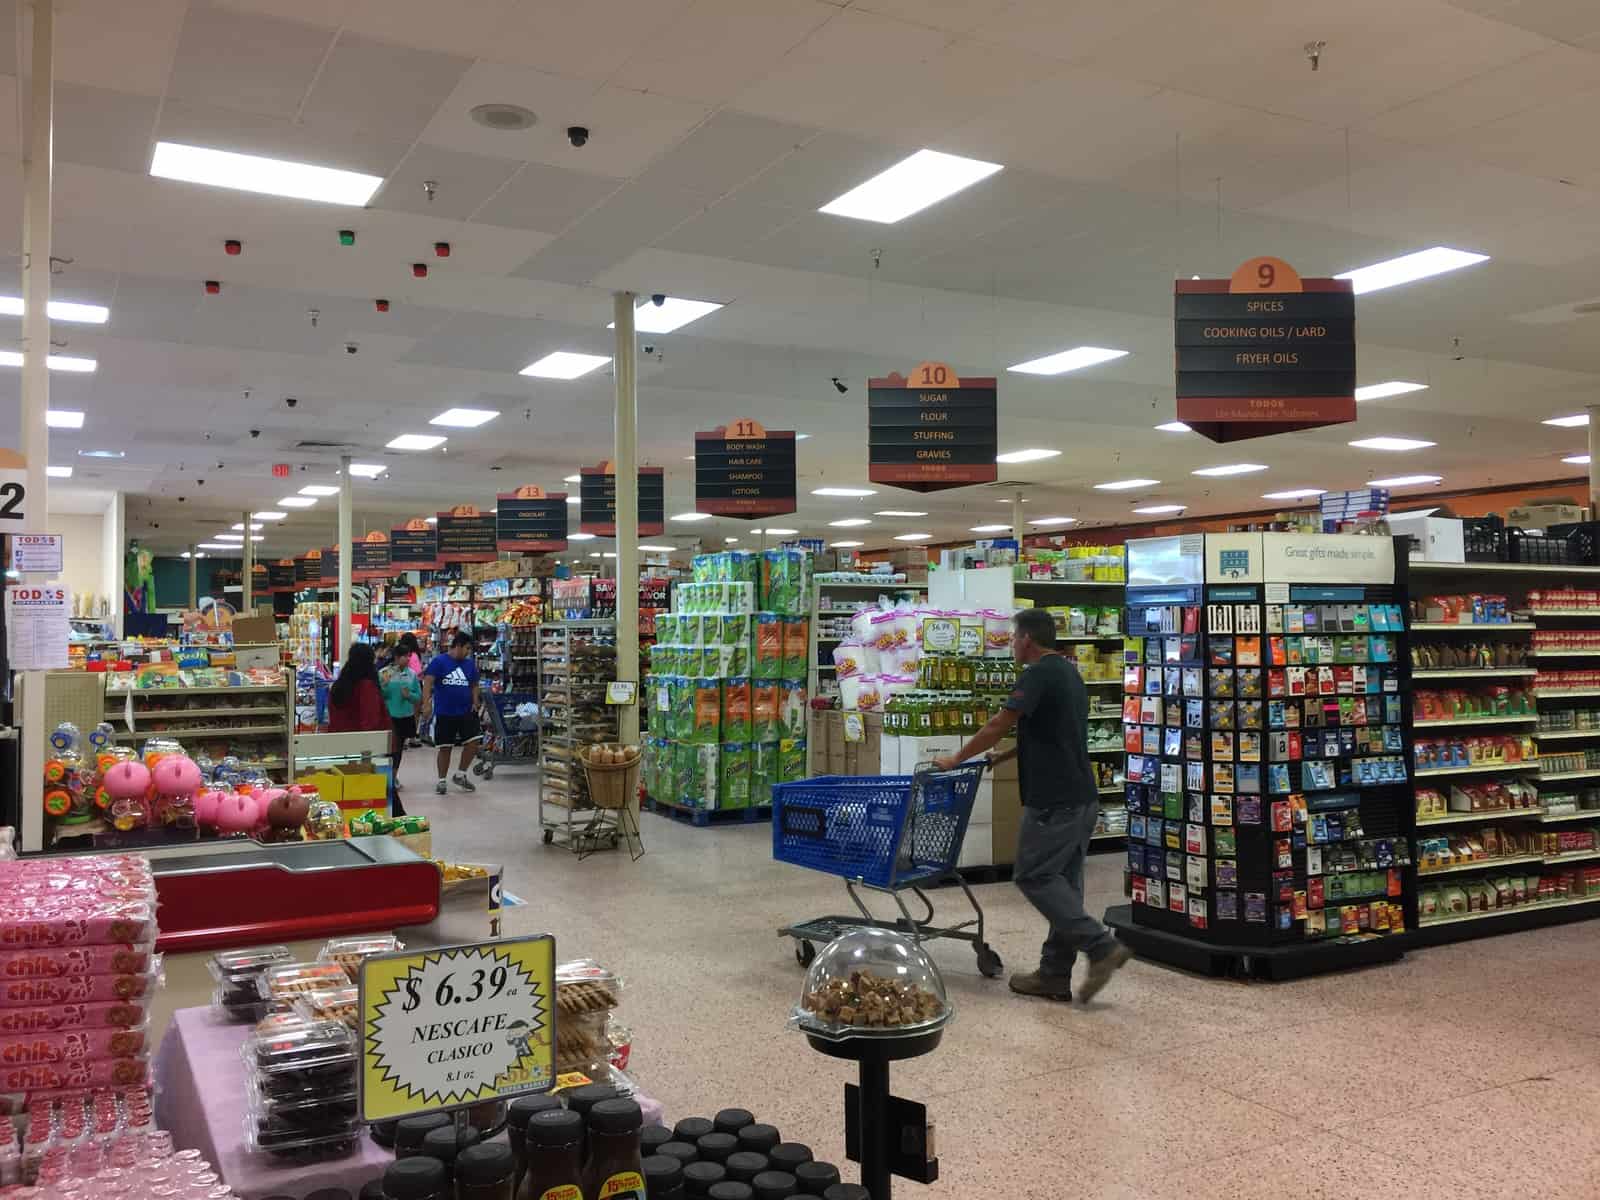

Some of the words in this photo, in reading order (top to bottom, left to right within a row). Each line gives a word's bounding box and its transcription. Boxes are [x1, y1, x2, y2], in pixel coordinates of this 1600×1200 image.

[1257, 264, 1275, 289] 9
[1247, 301, 1284, 312] SPICES
[1204, 327, 1257, 339] COOKING
[1259, 327, 1285, 338] OILS
[1287, 326, 1293, 339] /
[1296, 326, 1326, 337] LARD
[1236, 353, 1270, 364] FRYER
[1273, 353, 1298, 364] OILS
[921, 366, 947, 385] 10
[919, 393, 948, 402] SUGAR
[920, 412, 948, 421] FLOUR
[736, 422, 754, 436] 11
[913, 431, 954, 440] STUFFING
[916, 450, 951, 459] GRAVIES
[441, 678, 470, 687] adidas
[435, 965, 508, 1007] 6.39
[411, 1012, 508, 1044] NESCAFE
[426, 1042, 493, 1065] CLASICO
[445, 1071, 461, 1082] 8.1
[463, 1070, 475, 1079] oz
